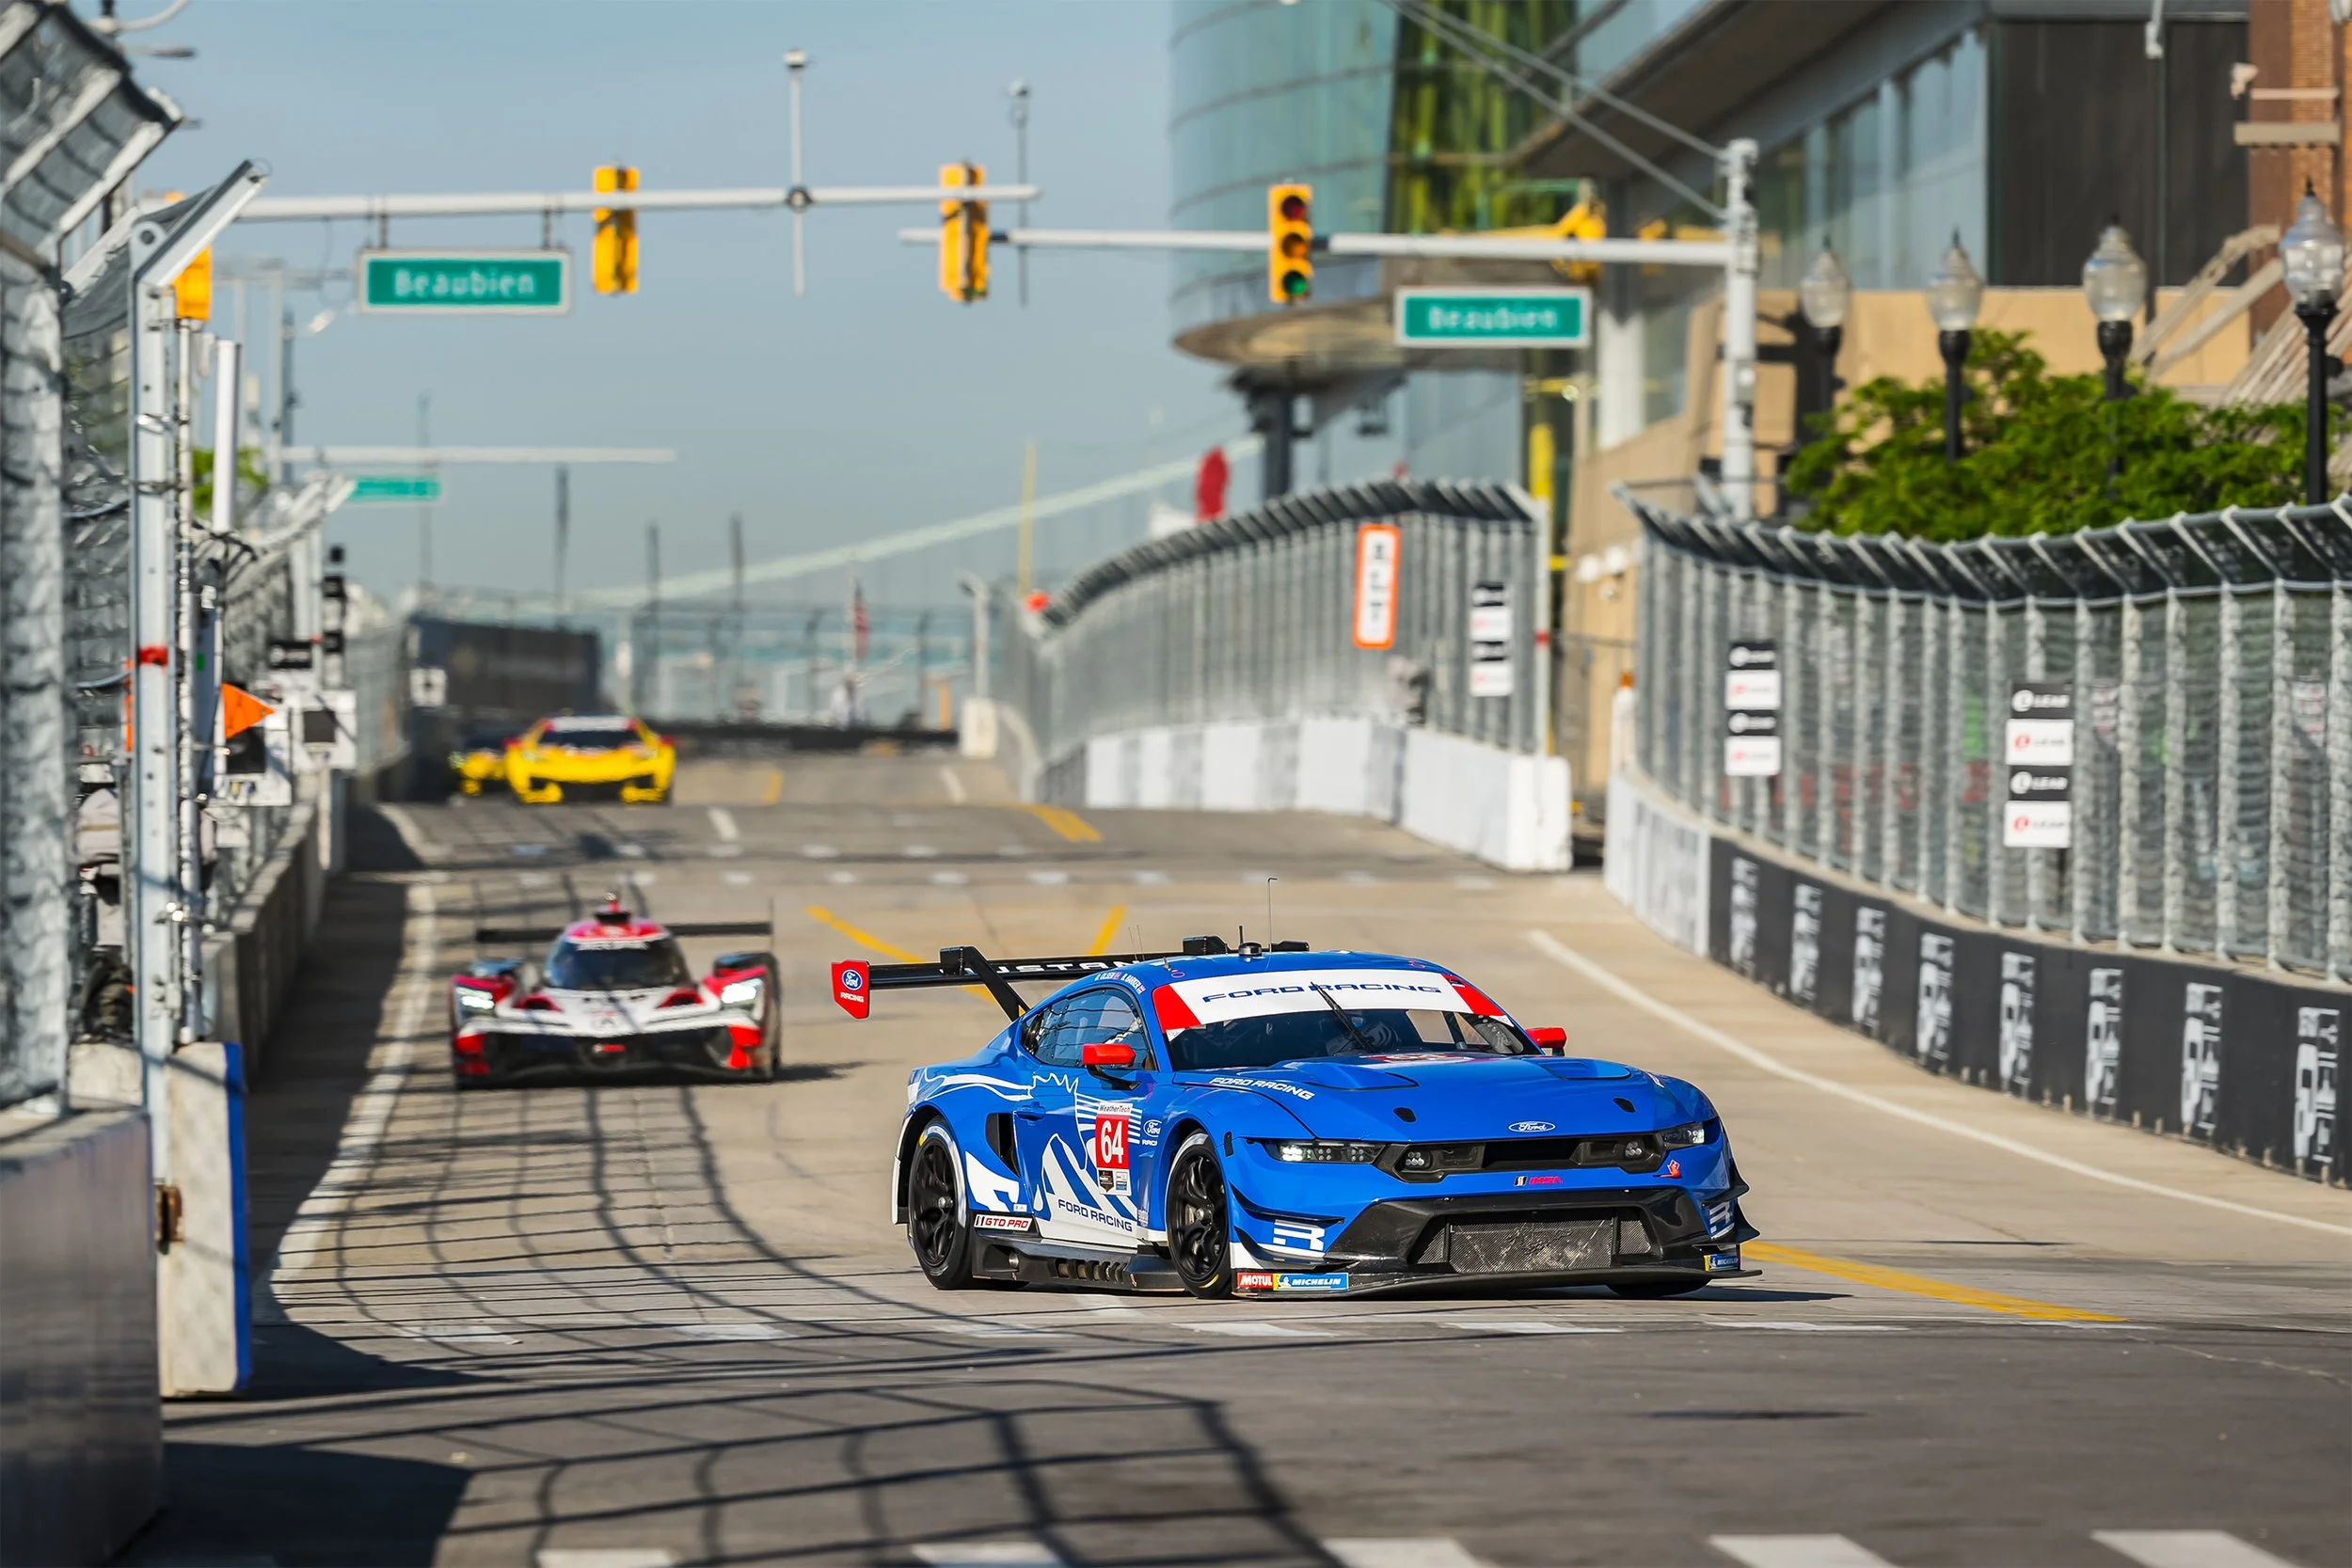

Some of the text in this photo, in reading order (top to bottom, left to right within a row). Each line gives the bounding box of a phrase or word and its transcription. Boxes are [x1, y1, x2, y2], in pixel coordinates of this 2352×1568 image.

[394, 267, 534, 297] Beaubien
[1428, 303, 1558, 331] Beaubien
[845, 972, 860, 988] Ford
[840, 991, 865, 1004] RACING
[1202, 984, 1442, 1003] FORD RACING
[1209, 1077, 1315, 1101] FORD RACING
[1099, 1104, 1131, 1114] WeatherTech
[1518, 1122, 1547, 1132] Ford
[1100, 1120, 1124, 1164] 64
[1529, 1176, 1564, 1185] IMSA
[1058, 1198, 1089, 1218] FORD
[1090, 1210, 1133, 1232] RACING
[984, 1217, 1029, 1228] GTD PRO
[1240, 1275, 1273, 1286] MOTUL
[1292, 1277, 1342, 1286] MICHELIN
